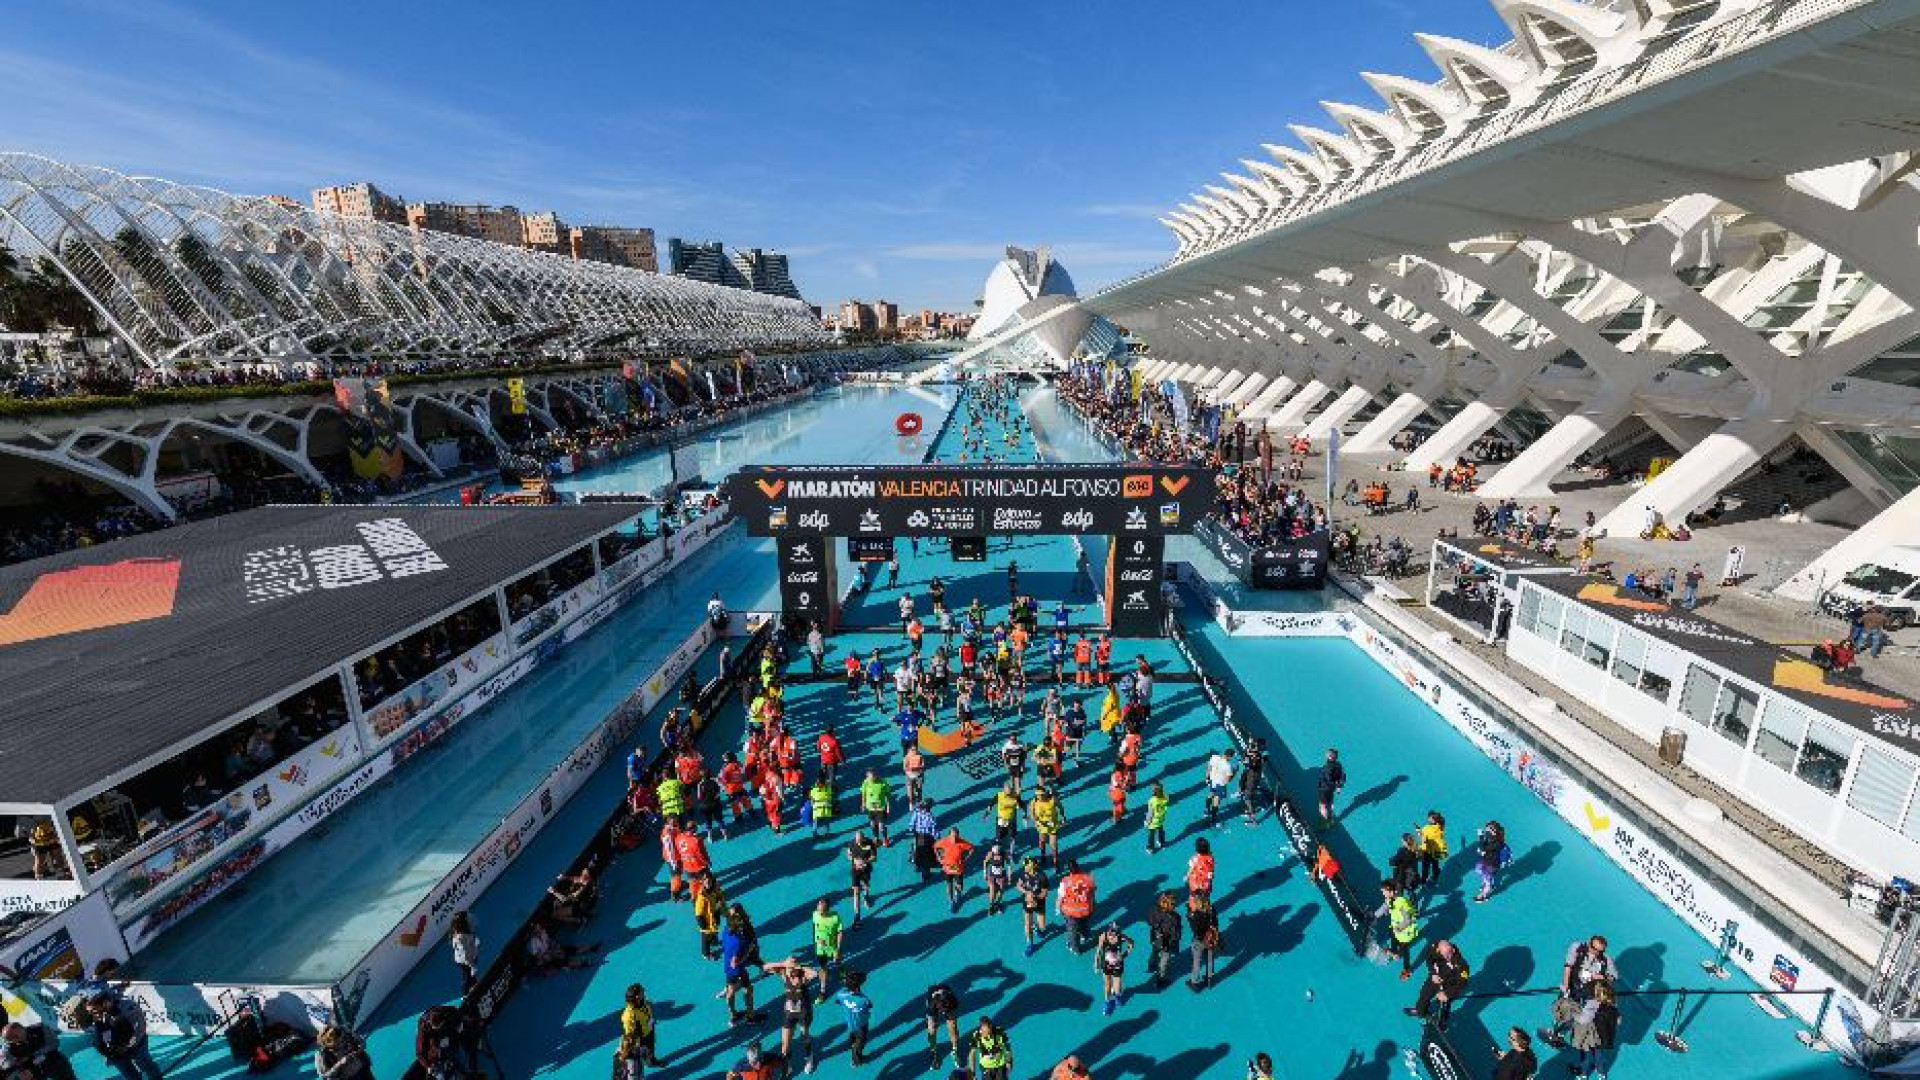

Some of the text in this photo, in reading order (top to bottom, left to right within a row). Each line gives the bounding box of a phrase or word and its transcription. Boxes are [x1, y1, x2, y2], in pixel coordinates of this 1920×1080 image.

[788, 475, 1120, 498] MARATÓN VALENCIA TRINIDAD ALFONSO
[798, 509, 829, 531] edp
[1062, 508, 1094, 531] edp
